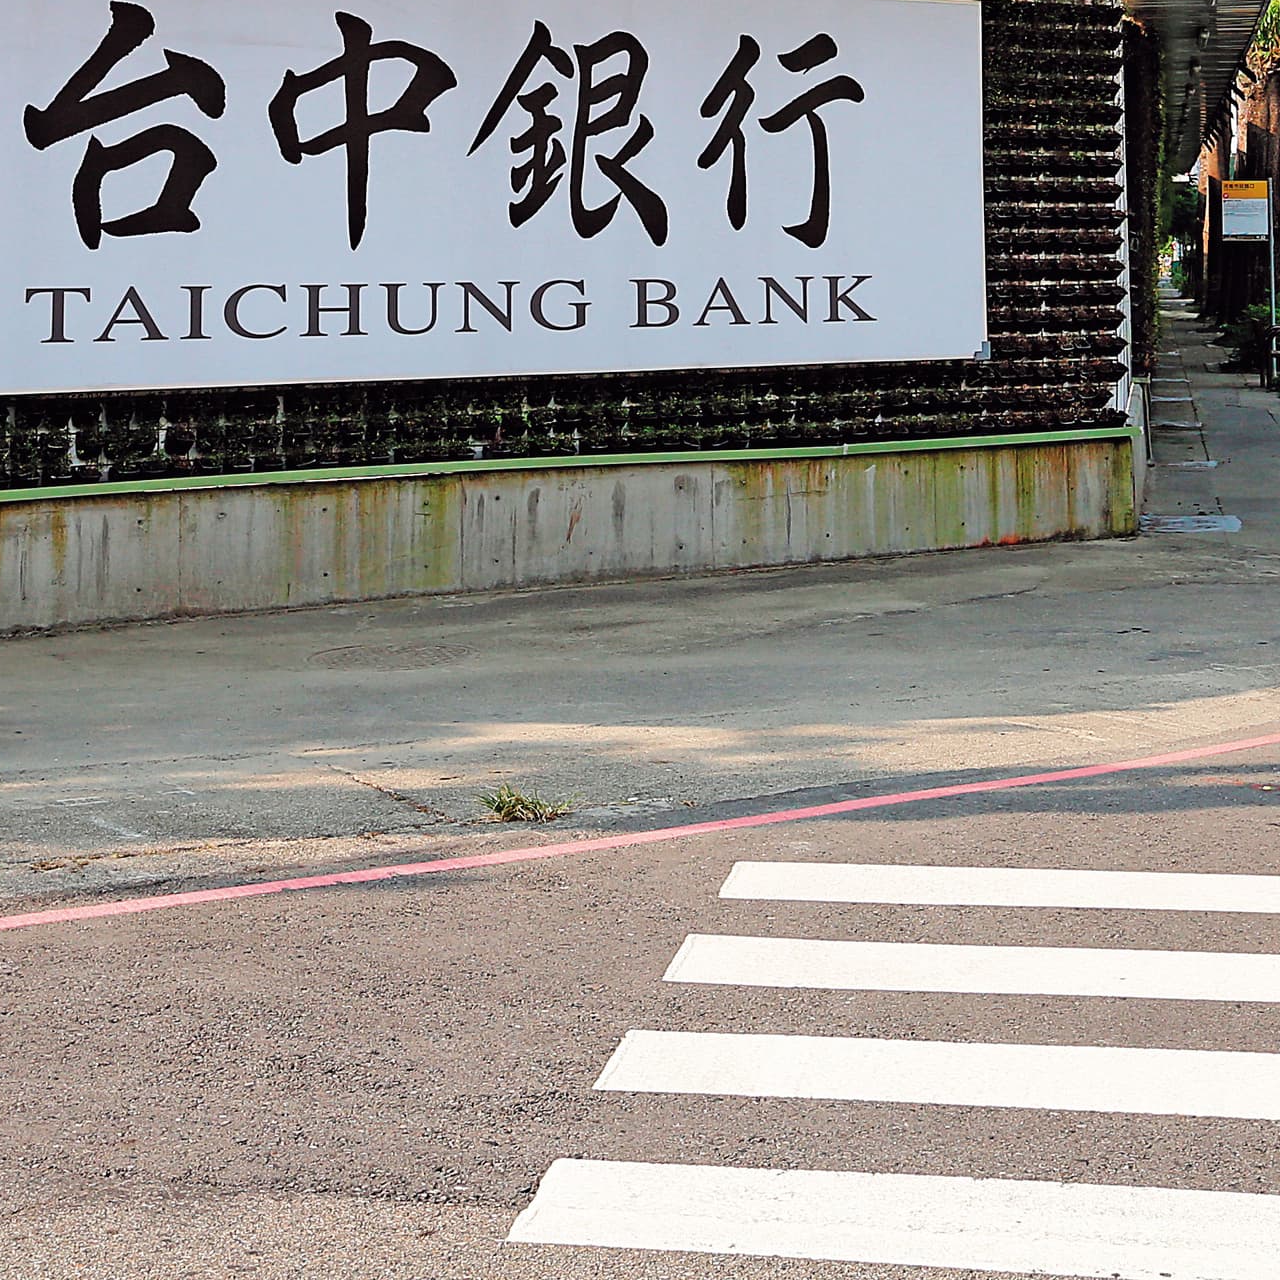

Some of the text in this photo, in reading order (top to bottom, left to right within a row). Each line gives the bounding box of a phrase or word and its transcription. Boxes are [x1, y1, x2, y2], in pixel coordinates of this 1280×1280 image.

[23, 0, 864, 251] 台中銀行
[24, 274, 876, 343] TAICHUNG BANK
